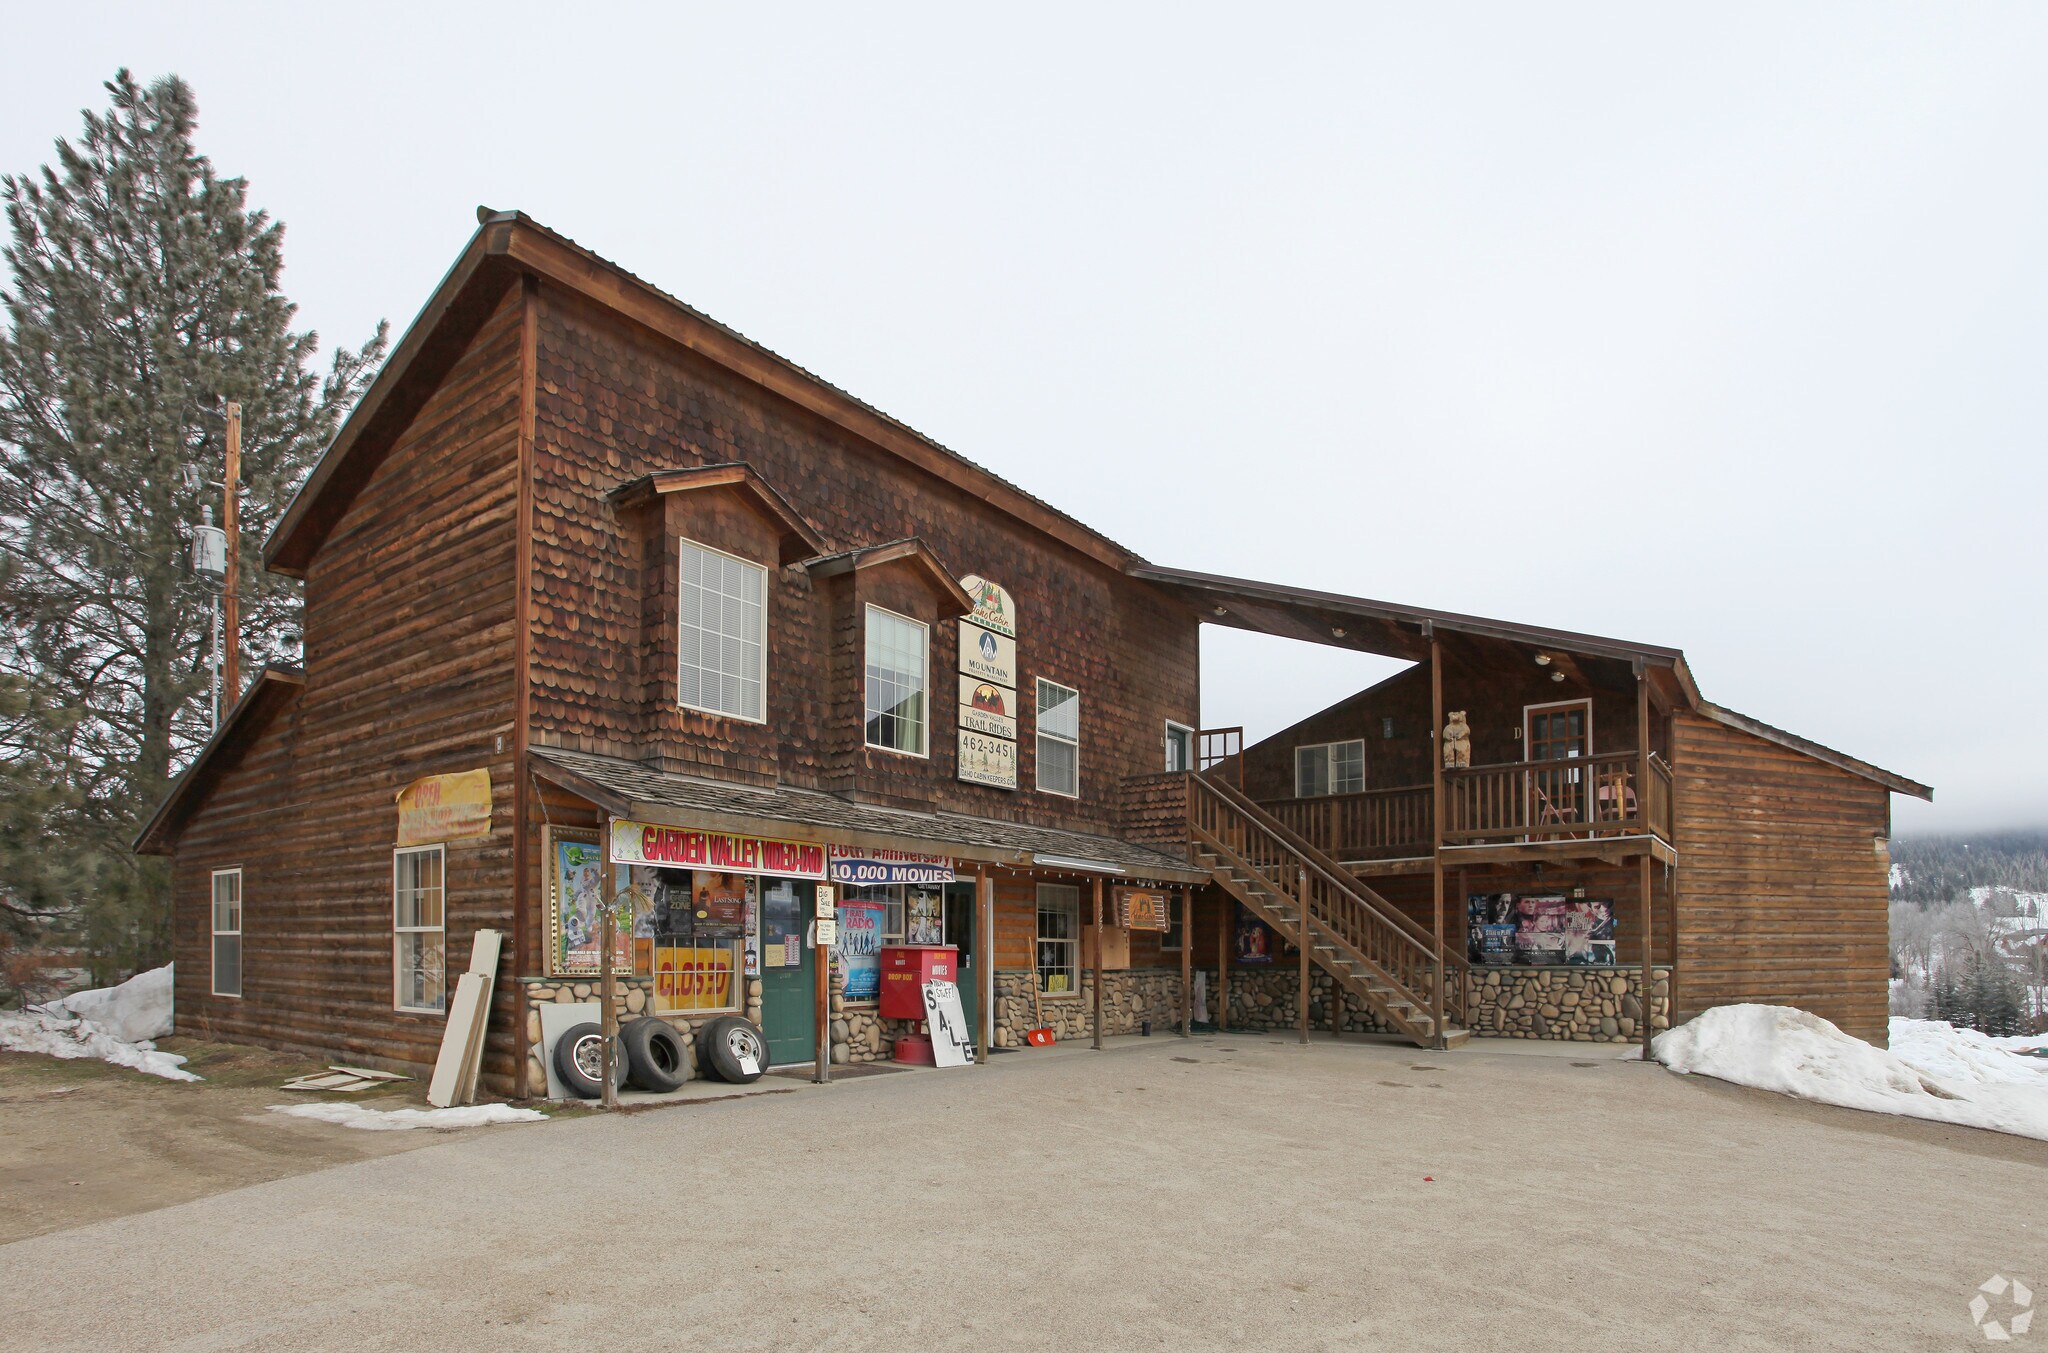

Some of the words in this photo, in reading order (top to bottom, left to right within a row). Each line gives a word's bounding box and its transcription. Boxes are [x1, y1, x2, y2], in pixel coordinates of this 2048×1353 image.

[989, 610, 1009, 627] Cabin
[968, 659, 1008, 678] MOUNTAIN
[972, 709, 989, 719] GARDEN
[964, 715, 987, 732] TRAIL
[988, 721, 1012, 738] RIDES
[1514, 726, 1522, 740] D
[963, 735, 1013, 759] 462-3451
[415, 782, 441, 809] OPEN
[643, 826, 706, 864] GARDEN
[708, 834, 760, 868] VALLEY
[760, 841, 823, 873] VIDEO-DVD
[830, 864, 888, 882] 10,000
[891, 867, 953, 882] MOVIES
[846, 909, 866, 919] PIRATE
[846, 917, 875, 929] RADIO
[659, 961, 727, 997] CLOSED
[888, 973, 901, 981] DROP
[902, 973, 913, 981] BOX
[926, 989, 974, 1062] SALE
